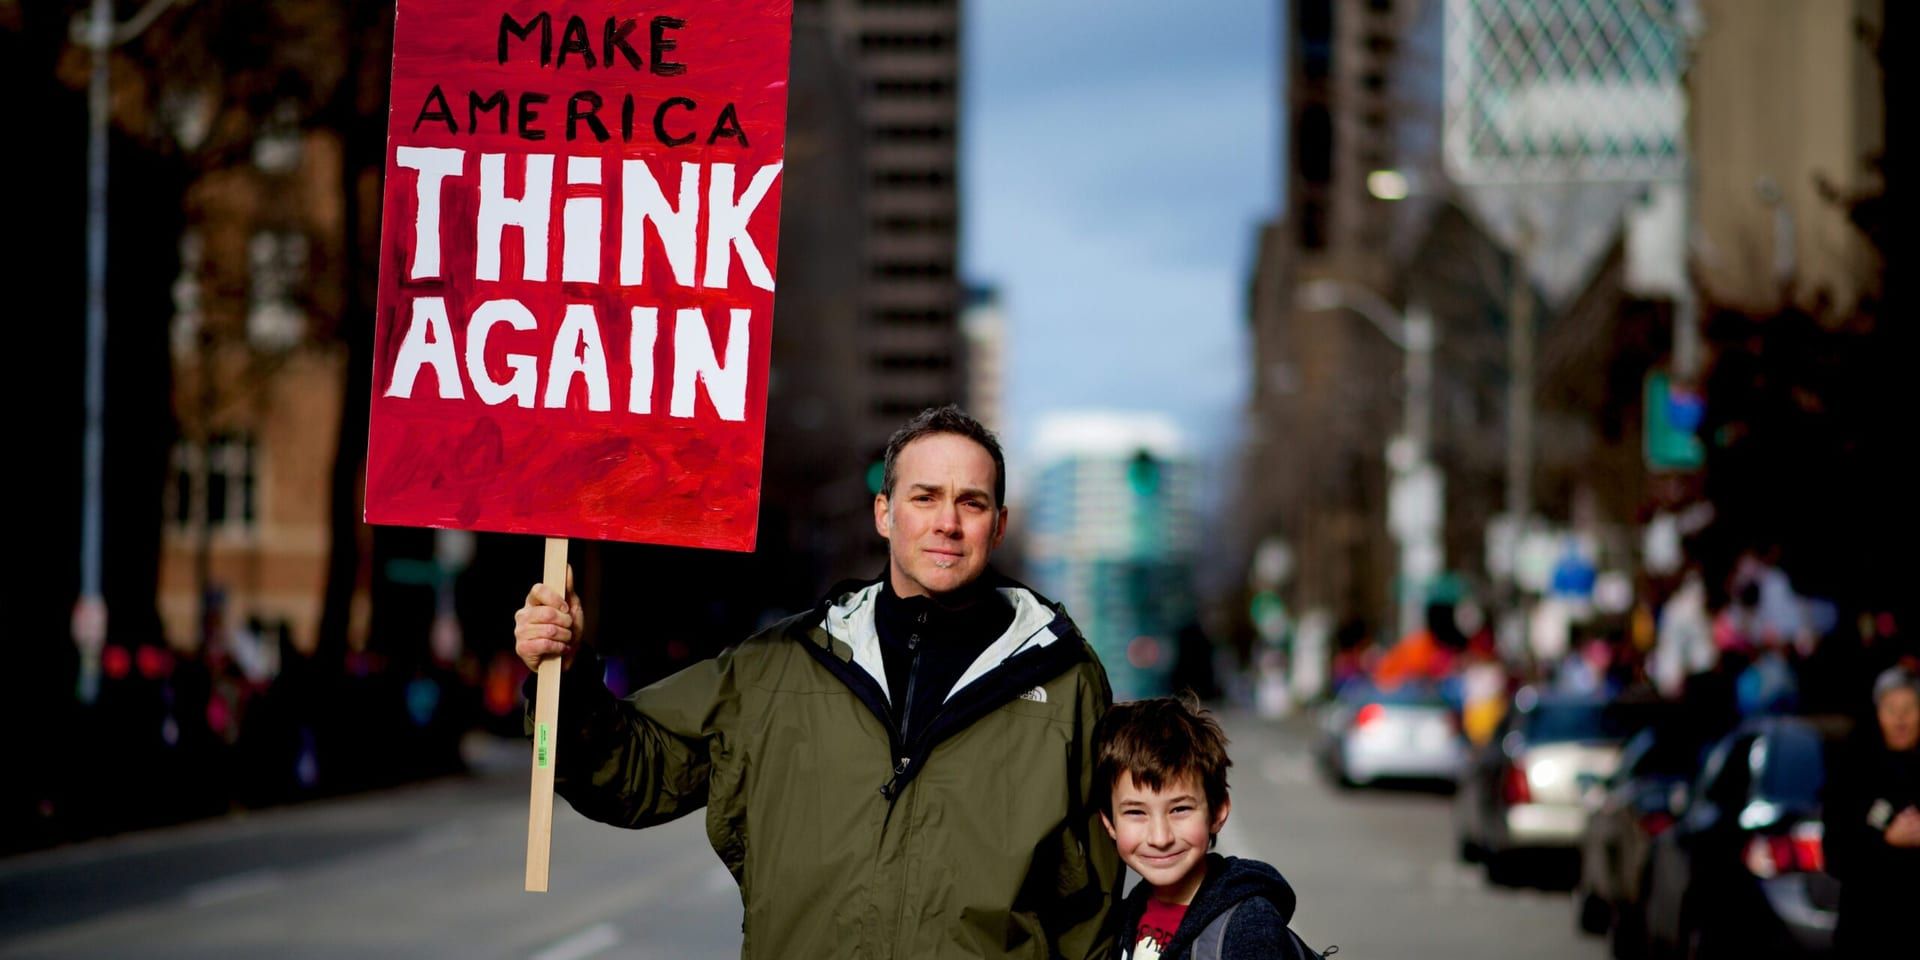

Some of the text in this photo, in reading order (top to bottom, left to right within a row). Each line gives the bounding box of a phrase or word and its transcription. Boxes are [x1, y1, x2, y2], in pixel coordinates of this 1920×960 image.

[498, 11, 687, 76] MAKE
[413, 85, 749, 148] AMERICA
[384, 297, 752, 422] AGAIN
